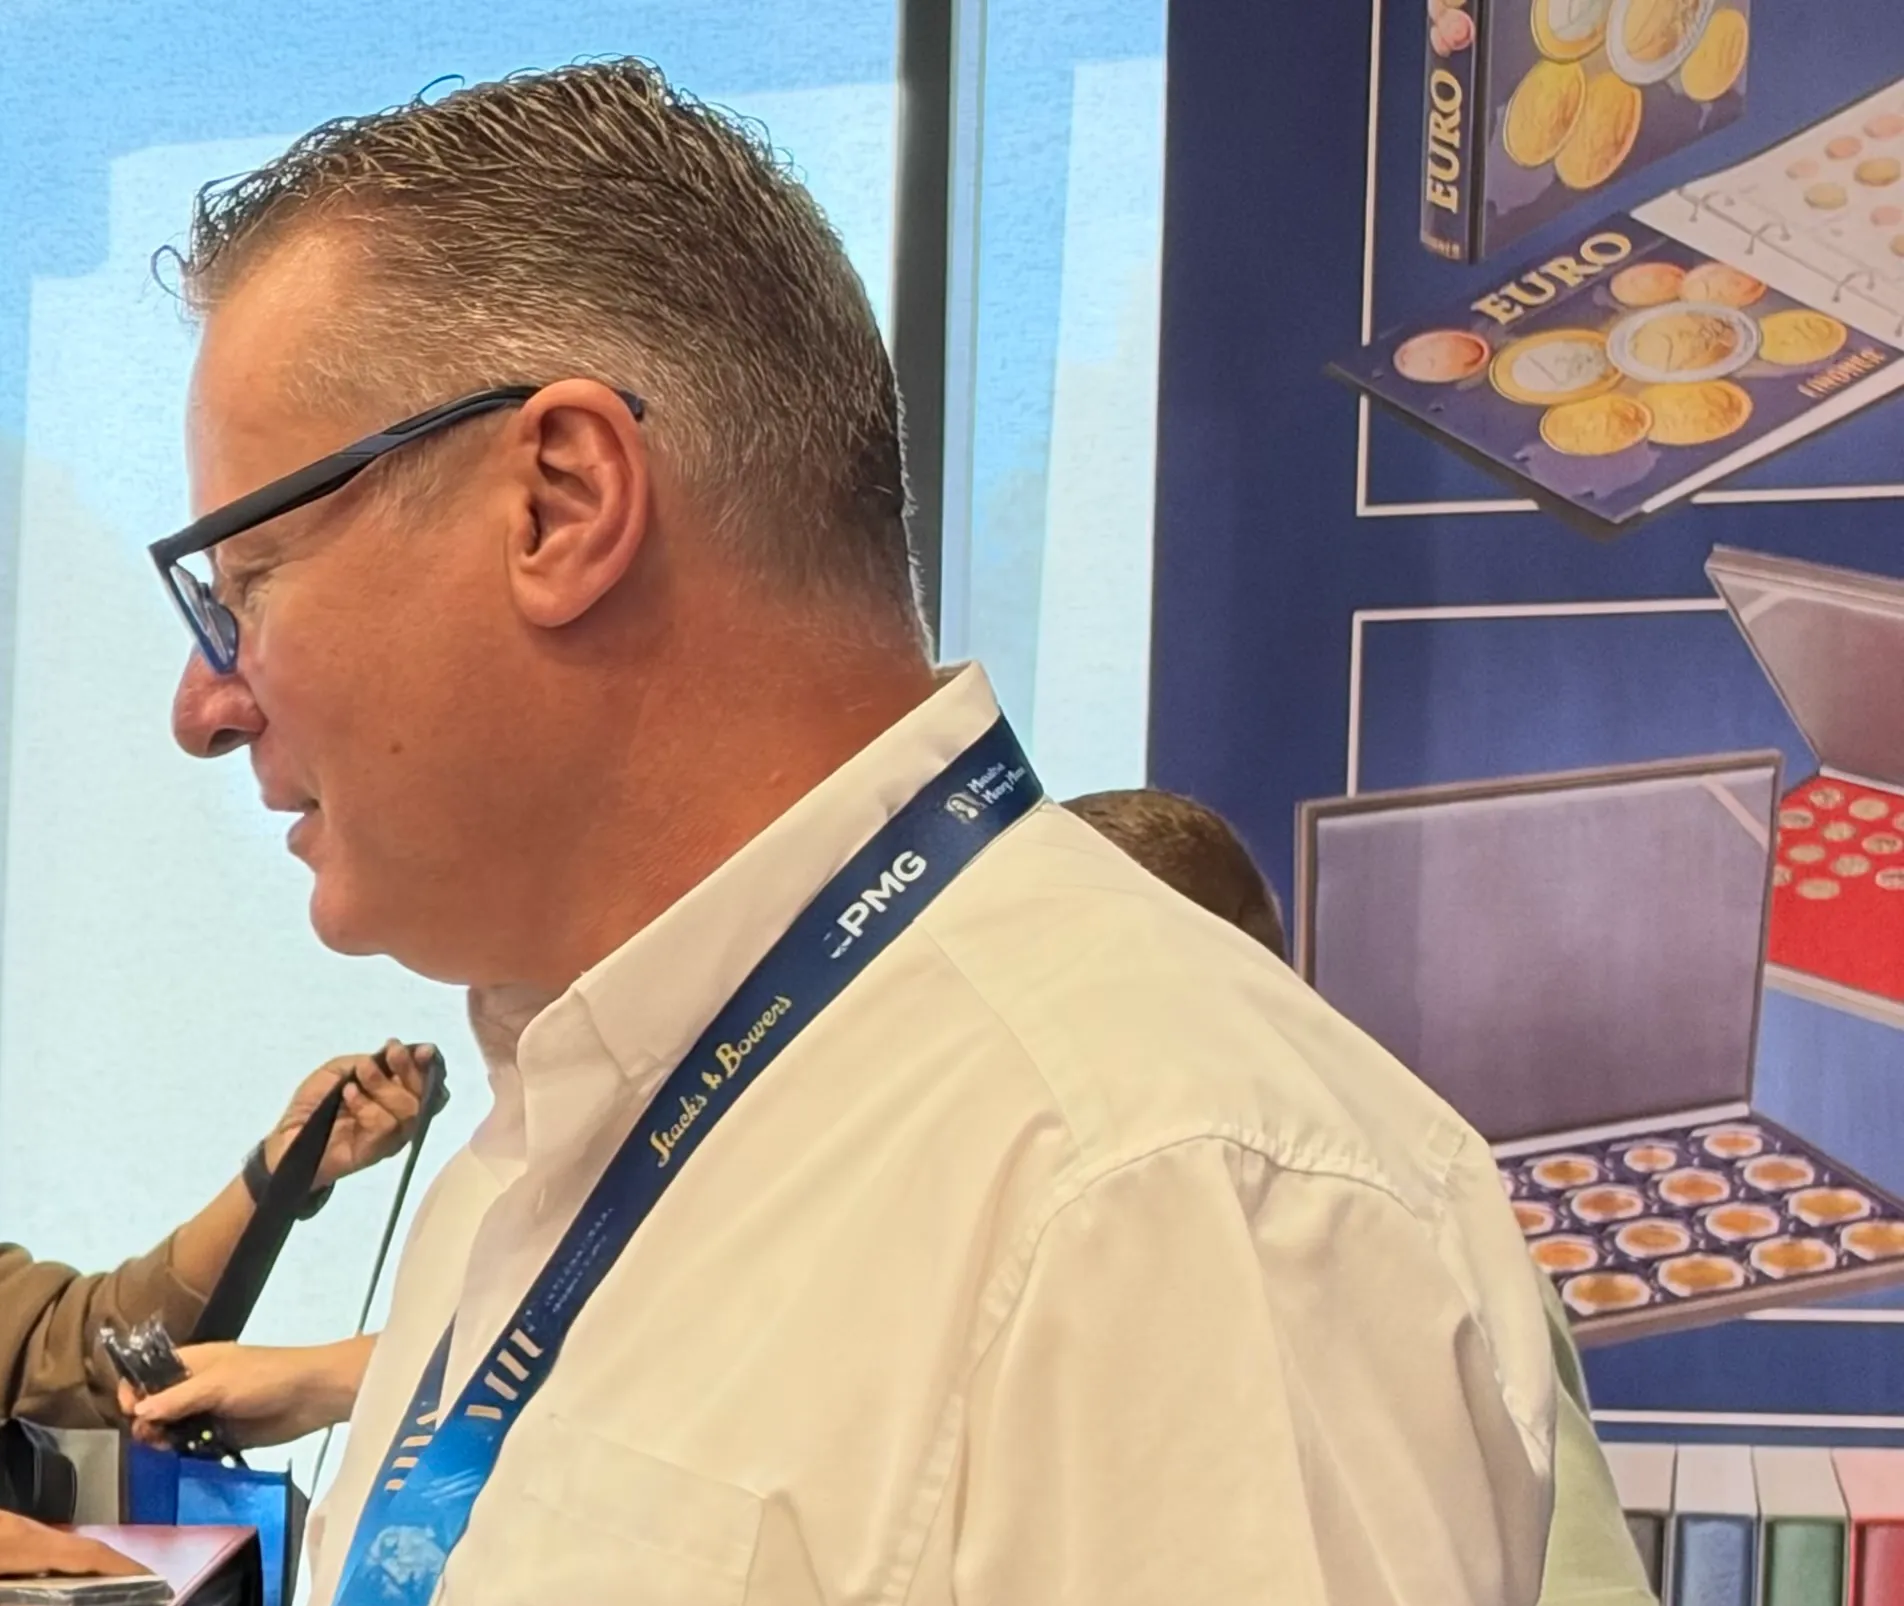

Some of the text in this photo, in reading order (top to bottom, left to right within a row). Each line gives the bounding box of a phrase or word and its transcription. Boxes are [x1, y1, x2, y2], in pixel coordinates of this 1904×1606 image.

[1425, 69, 1464, 214] EURO
[1470, 231, 1632, 327] EURO
[837, 850, 928, 941] PMG
[721, 992, 793, 1079] Bowers
